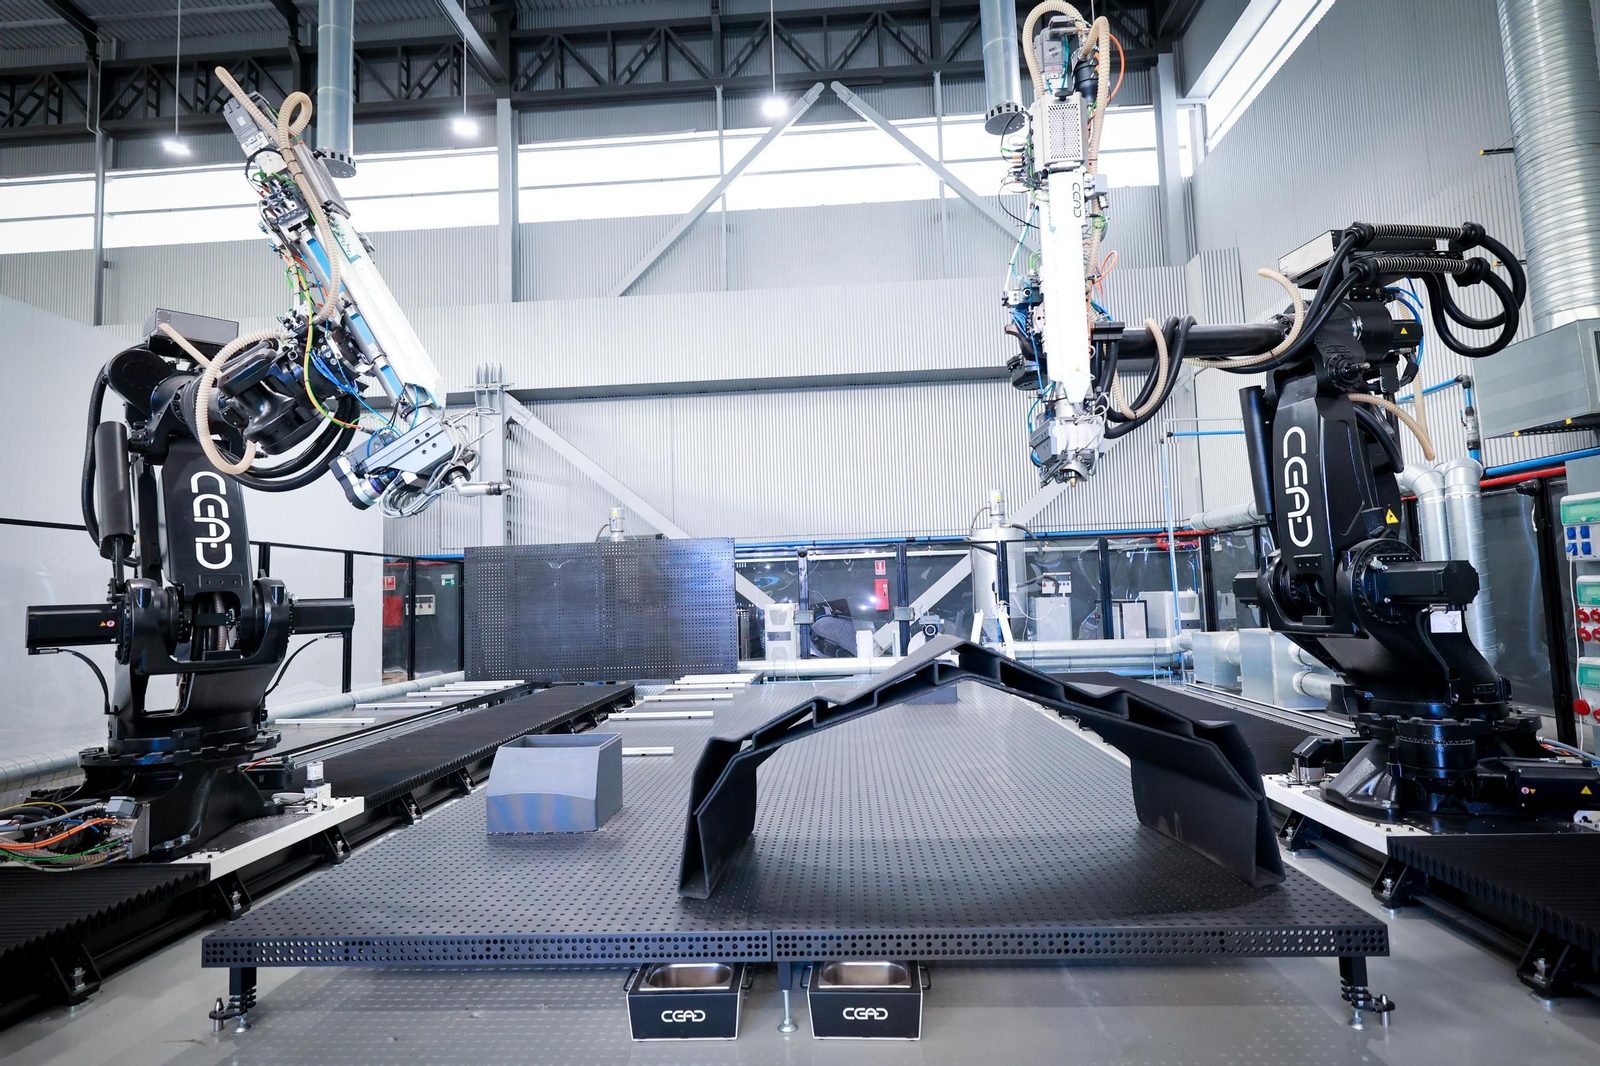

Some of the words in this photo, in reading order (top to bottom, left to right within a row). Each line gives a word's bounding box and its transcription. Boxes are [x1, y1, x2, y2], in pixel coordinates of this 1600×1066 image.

[1283, 426, 1313, 547] CEAD
[190, 471, 233, 570] CEAD
[661, 1009, 706, 1023] CEAD
[842, 1007, 889, 1021] CEAD
